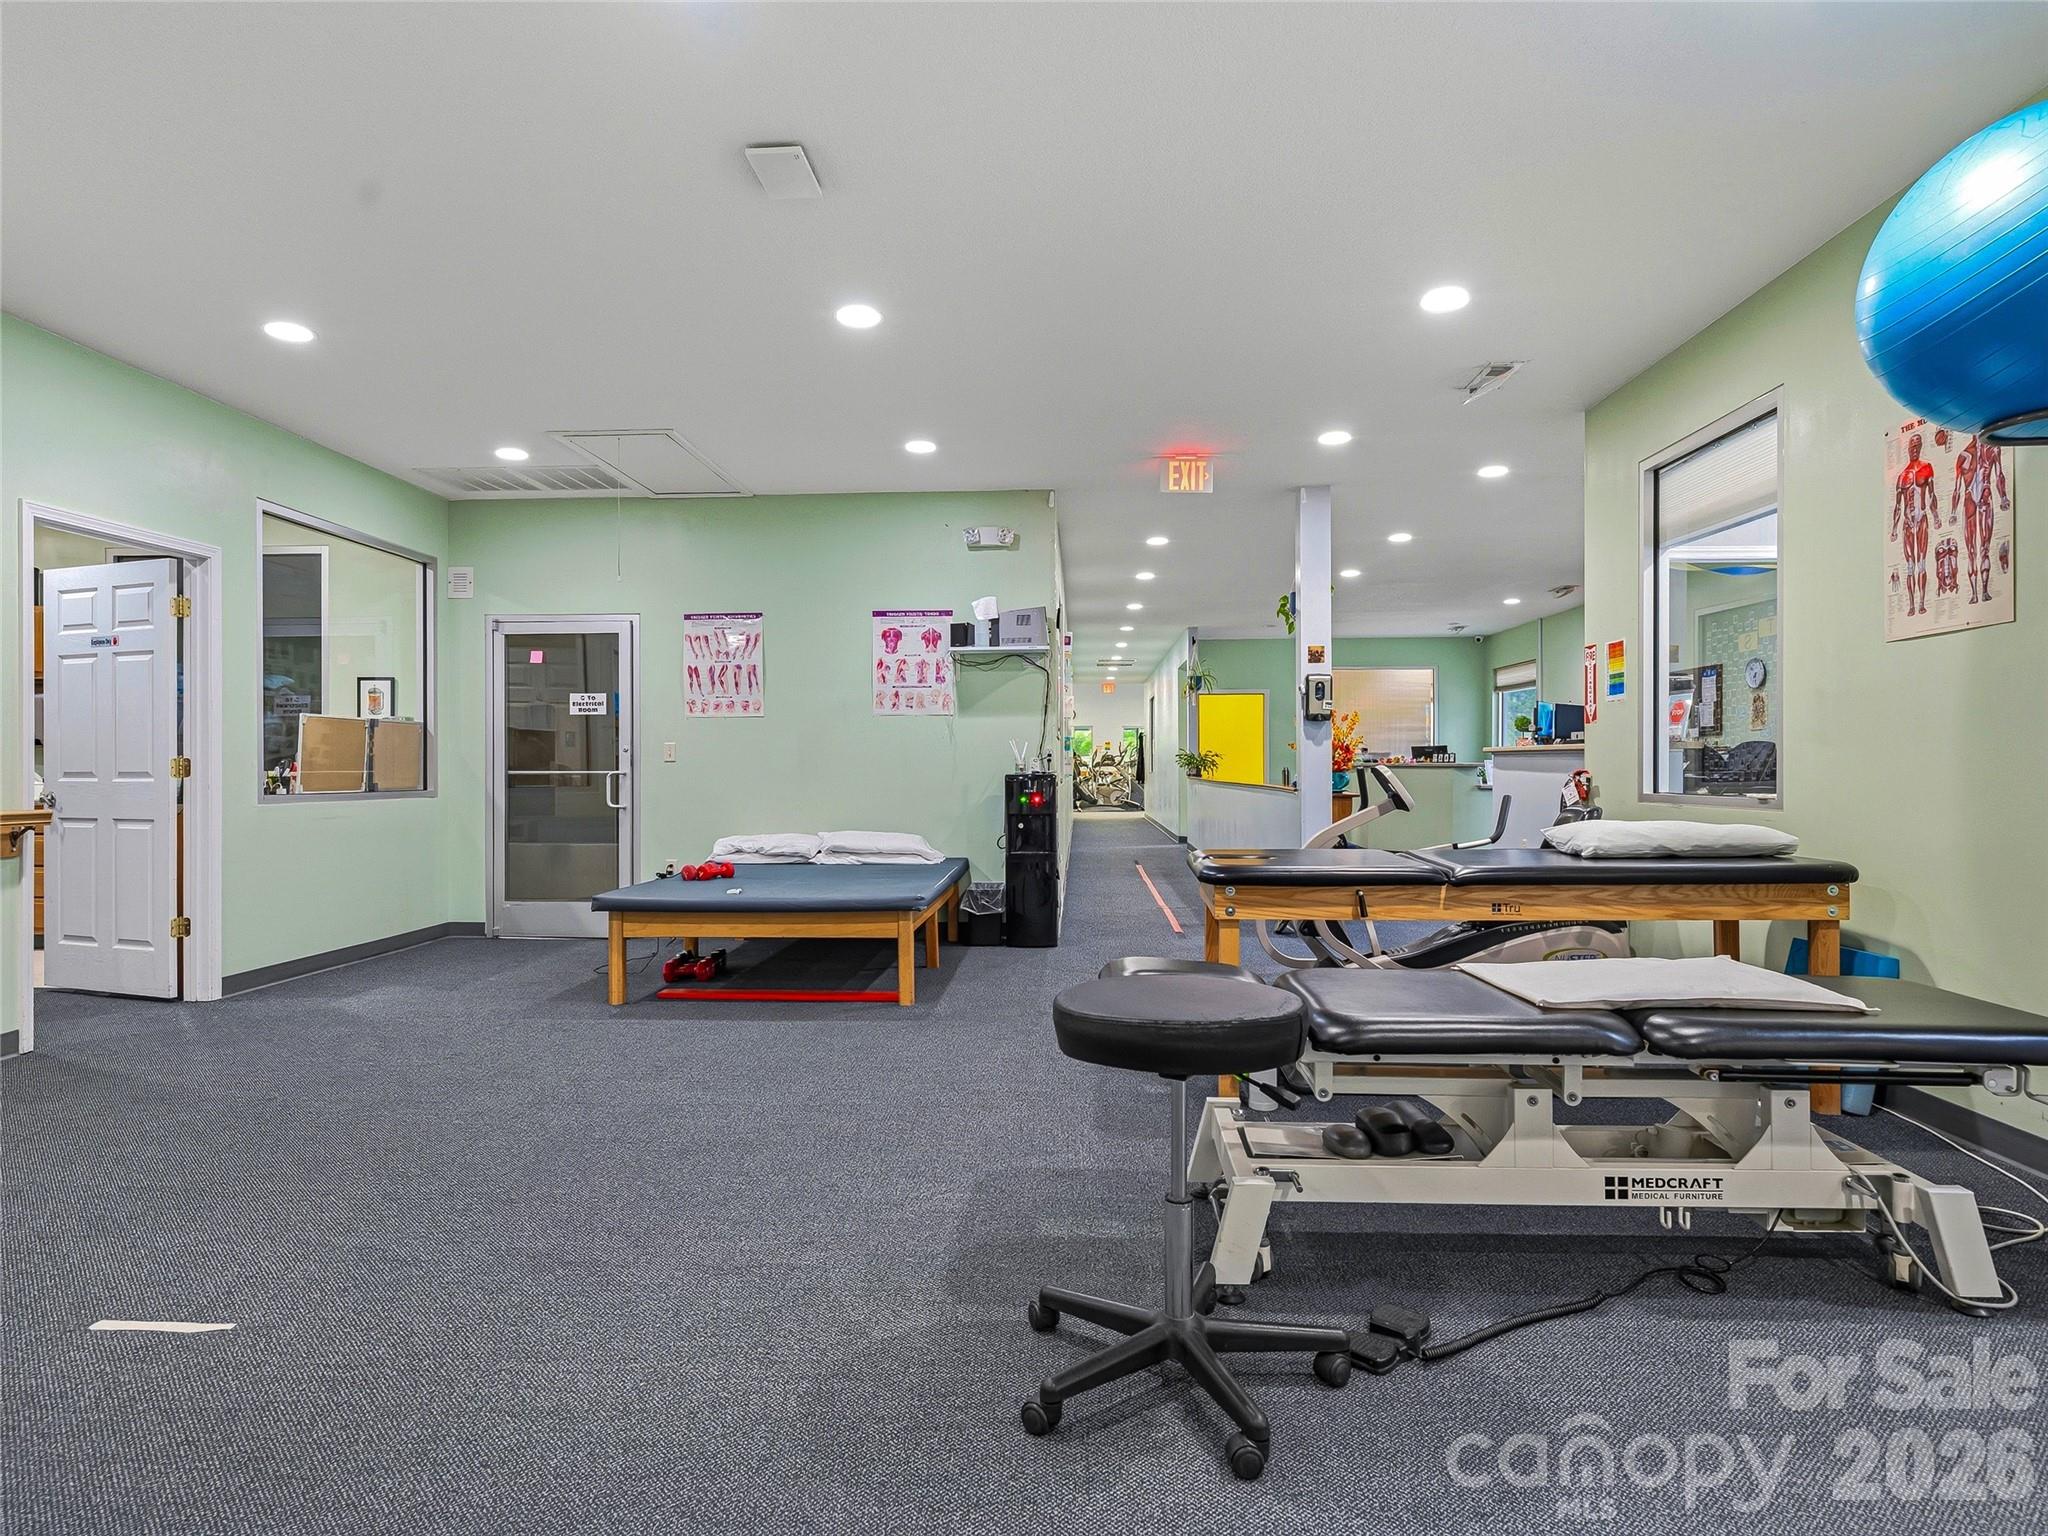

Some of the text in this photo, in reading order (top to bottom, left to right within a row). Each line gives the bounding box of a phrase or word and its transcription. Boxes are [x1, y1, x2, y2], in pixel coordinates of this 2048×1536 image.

[1901, 423, 1915, 433] THE
[1168, 460, 1207, 491] EXIT
[1503, 903, 1521, 912] Tru
[1631, 1177, 1724, 1189] MEDCRAFT
[1631, 1192, 1724, 1200] MEDICAL FURNITURE
